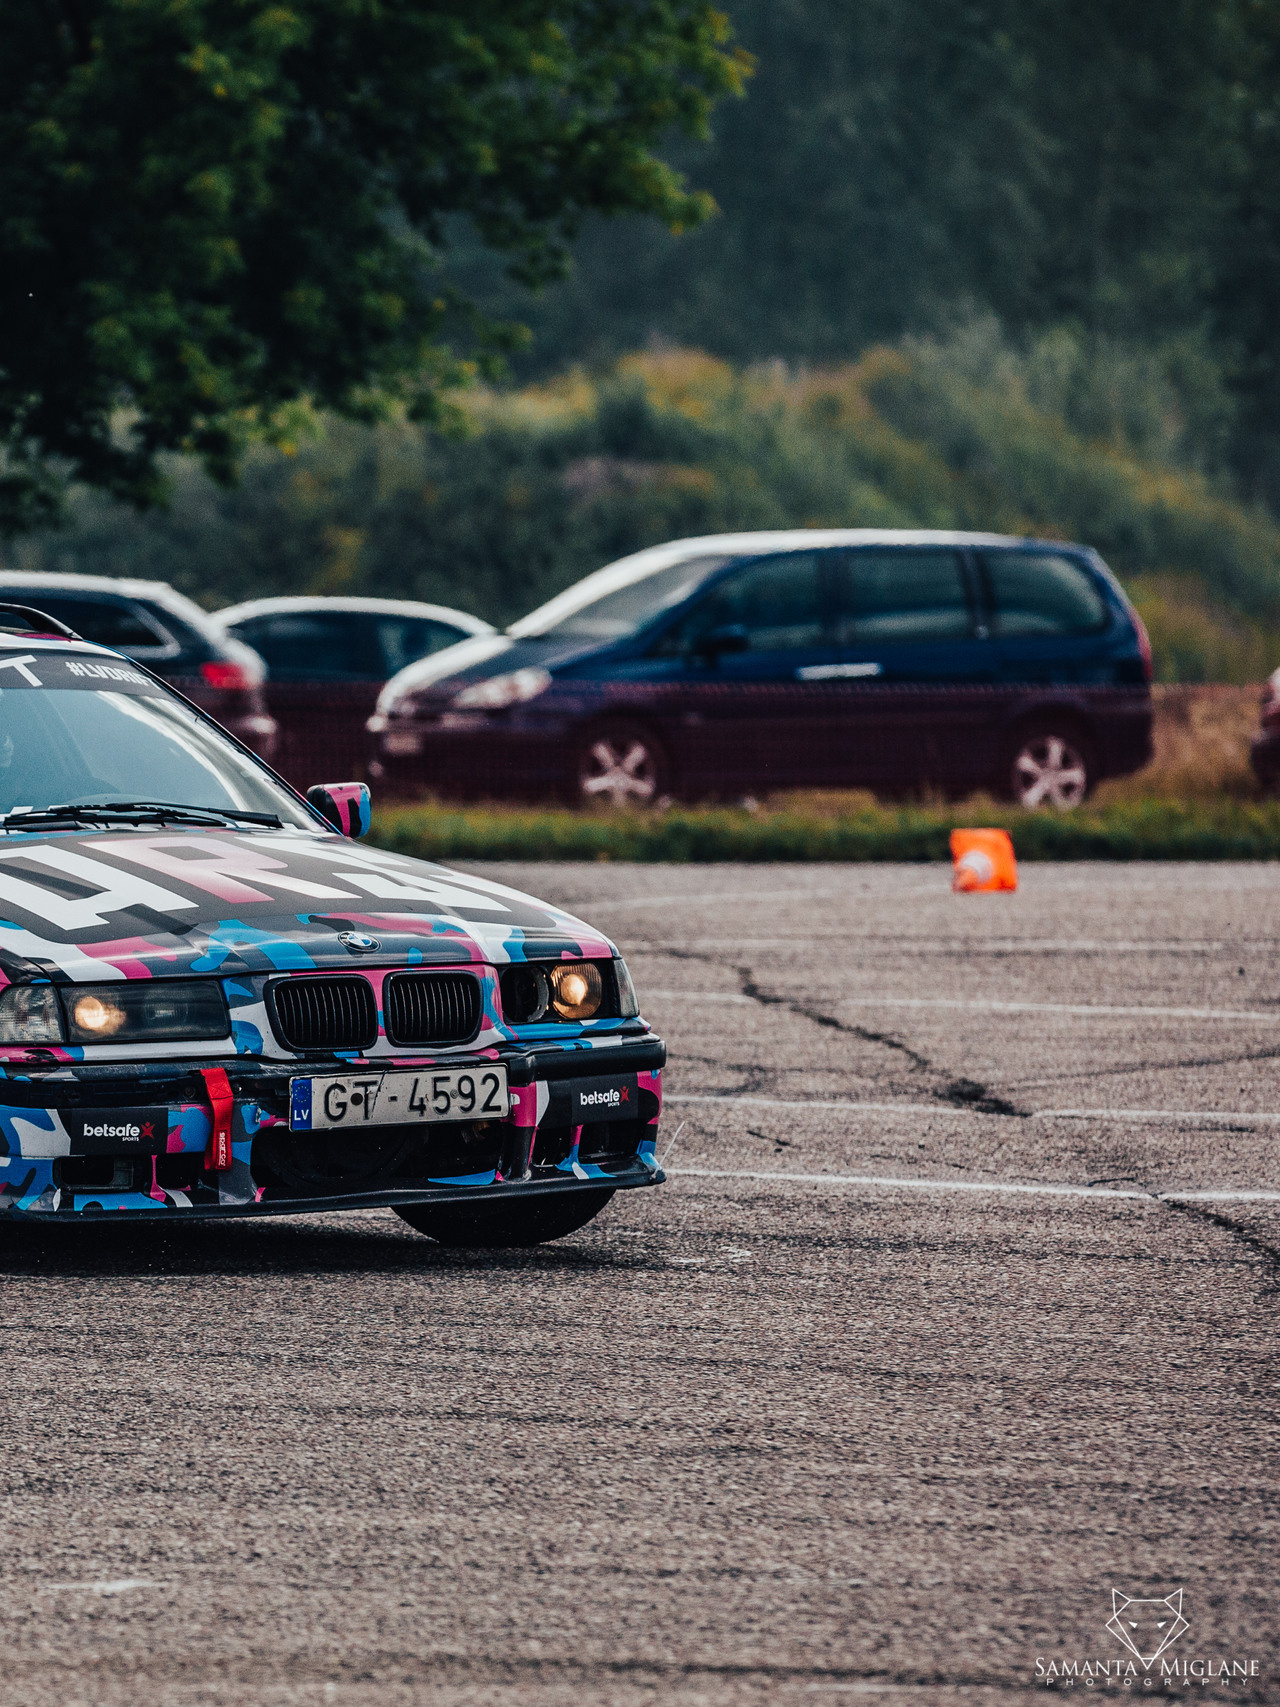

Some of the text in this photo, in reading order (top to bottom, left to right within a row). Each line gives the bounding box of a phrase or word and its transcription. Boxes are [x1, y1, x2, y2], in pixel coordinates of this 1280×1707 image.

[580, 1088, 620, 1106] betsafe
[294, 1109, 309, 1121] LV
[83, 1123, 140, 1137] betsafe
